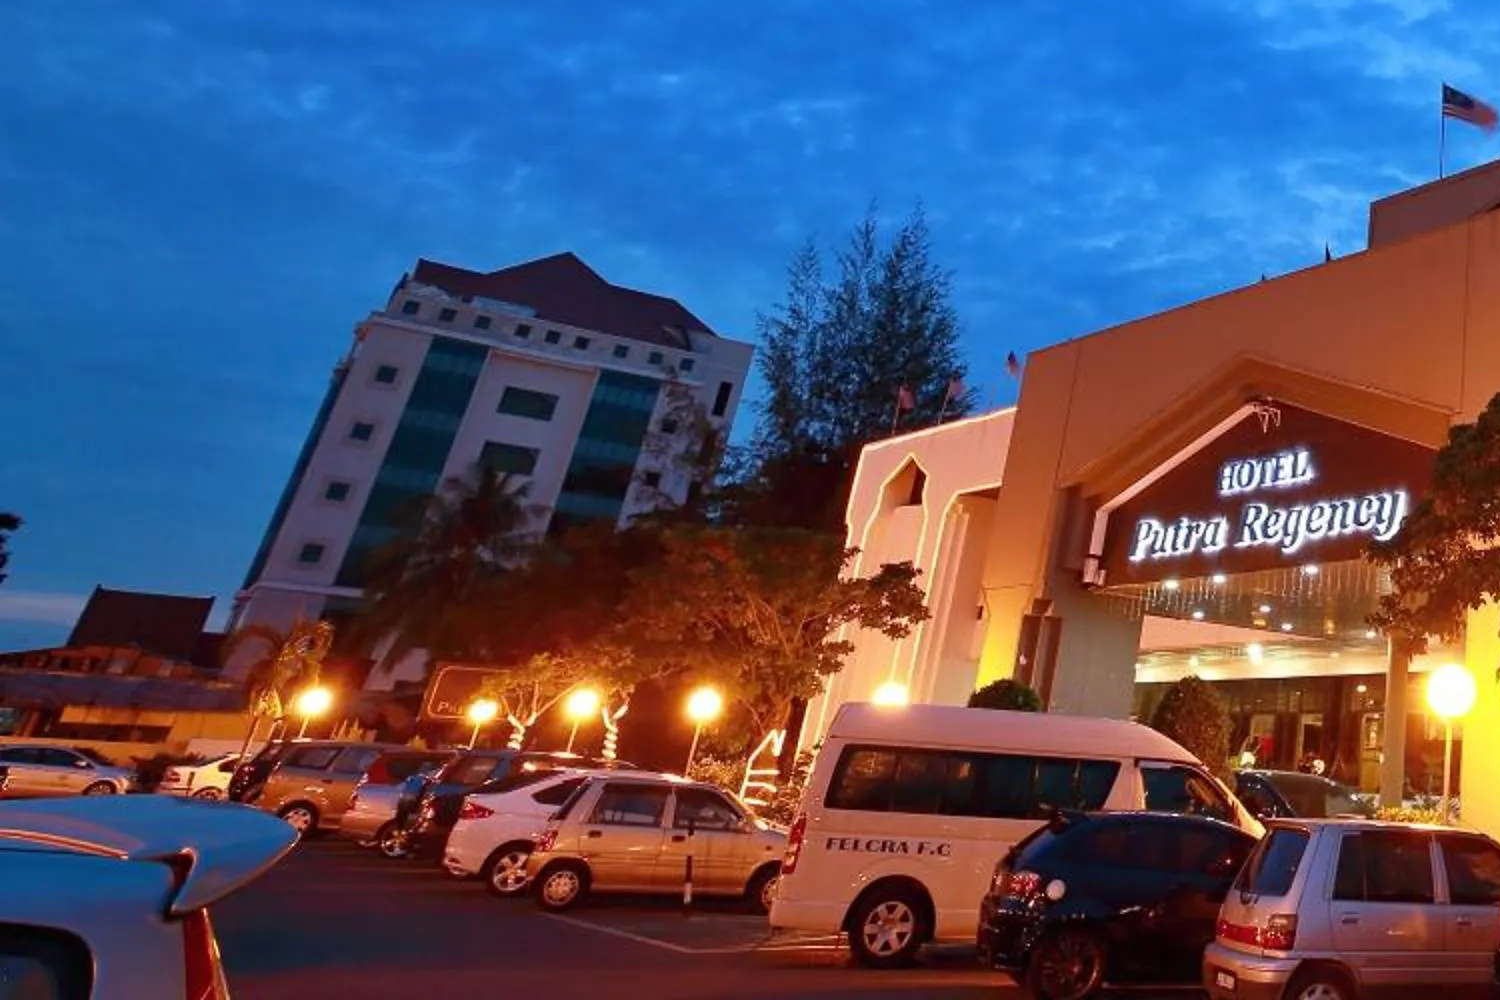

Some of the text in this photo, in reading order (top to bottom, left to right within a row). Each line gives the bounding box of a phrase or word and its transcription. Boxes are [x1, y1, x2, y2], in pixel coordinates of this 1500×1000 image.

[1217, 449, 1315, 496] HOTEL
[1128, 489, 1408, 562] Putra Regency
[825, 836, 909, 855] FELCRA
